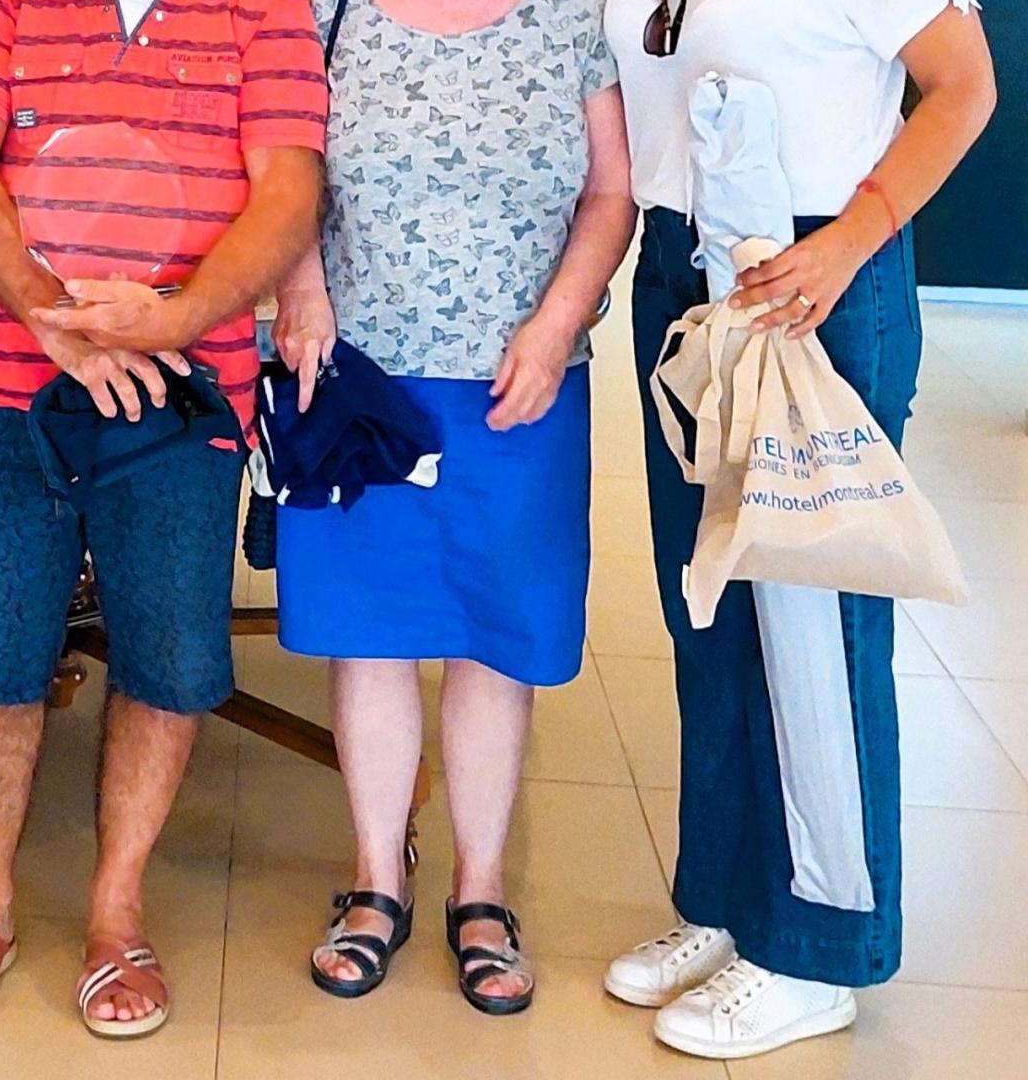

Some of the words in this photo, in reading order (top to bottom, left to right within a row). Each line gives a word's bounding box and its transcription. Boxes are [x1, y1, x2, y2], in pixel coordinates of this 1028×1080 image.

[752, 436, 788, 461] TEL
[793, 468, 811, 480] EN
[739, 479, 904, 511] ww.hotelmontreal.es
